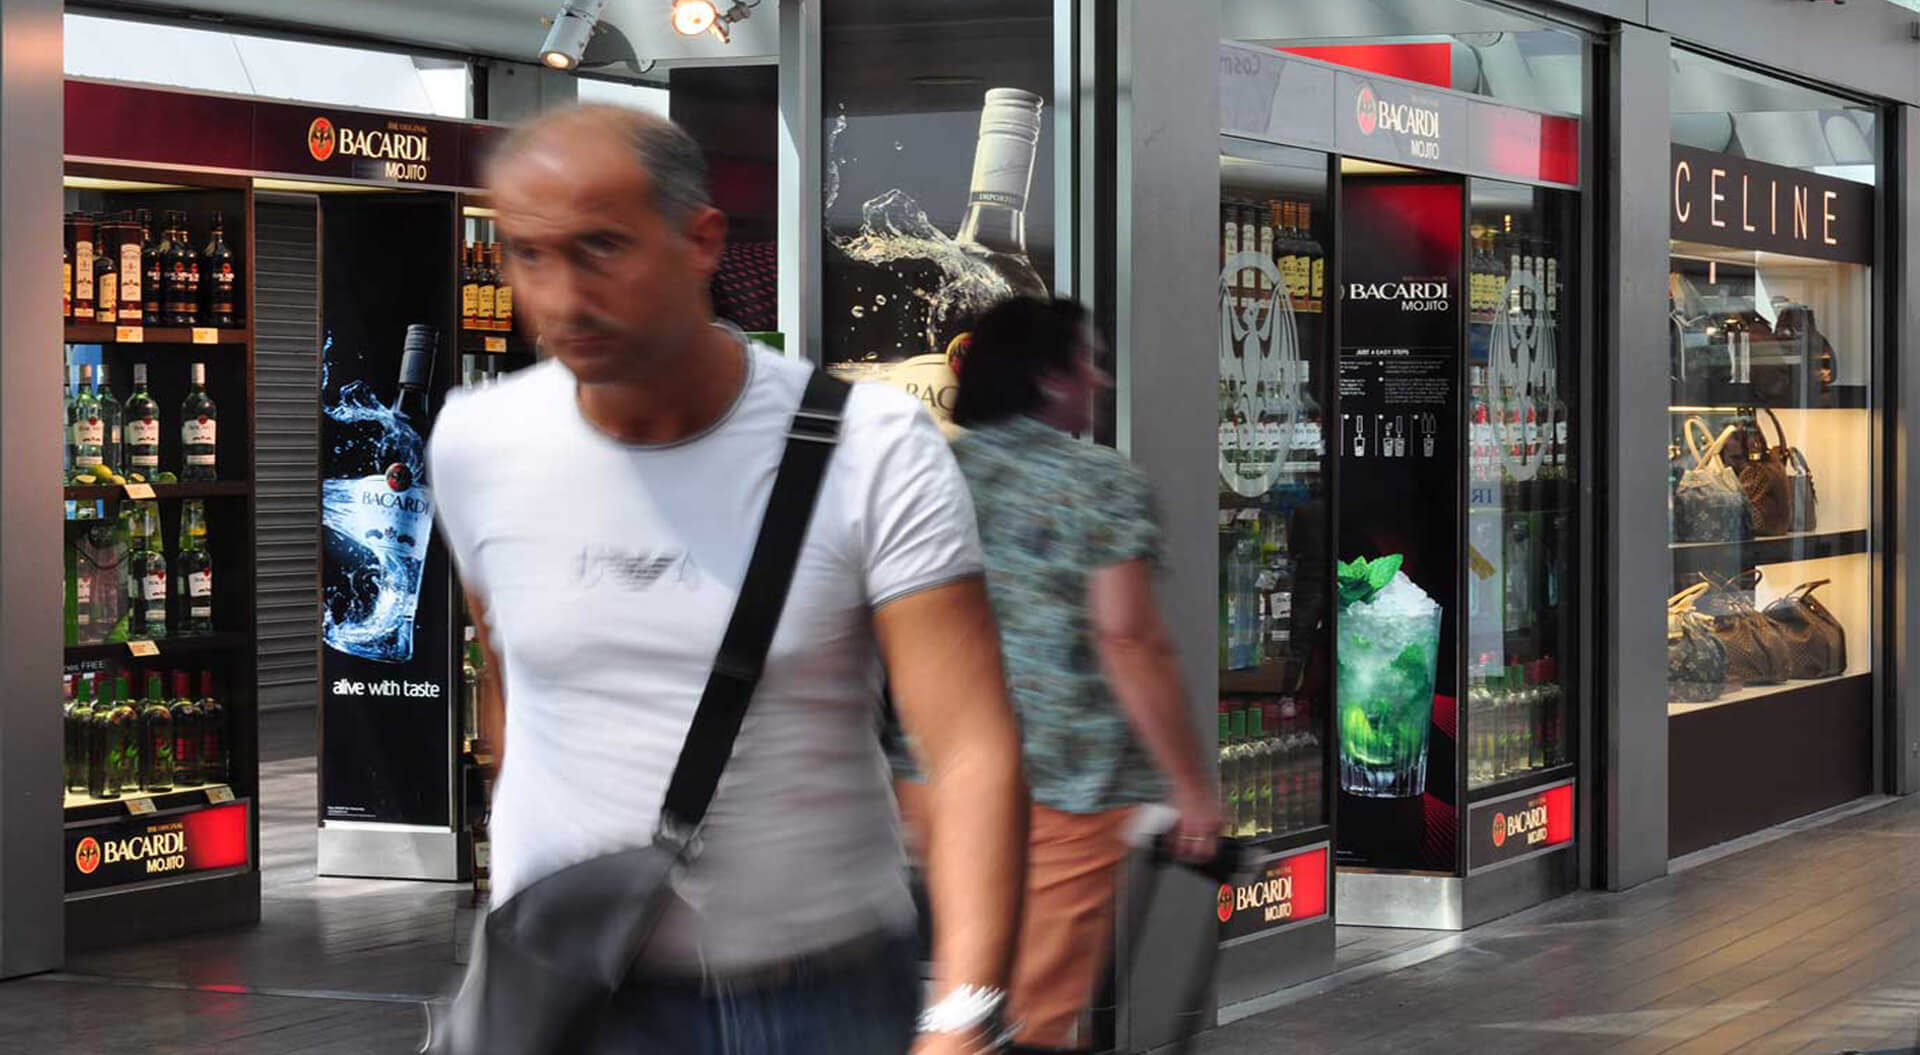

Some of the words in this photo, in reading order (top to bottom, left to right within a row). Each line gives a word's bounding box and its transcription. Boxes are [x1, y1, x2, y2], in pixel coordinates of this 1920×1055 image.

[1379, 100, 1439, 139] BACARDI
[339, 127, 430, 161] BACARDI
[1411, 139, 1439, 160] MOJITO
[385, 161, 427, 181] MOJITO
[1675, 160, 1837, 245] CELINE
[1350, 282, 1448, 301] BACARDI
[1401, 300, 1449, 312] MOJITO
[362, 491, 431, 515] BACARDI
[333, 679, 365, 696] alive
[368, 680, 401, 697] with
[403, 681, 440, 698] taste
[1507, 805, 1547, 837] BACARDI
[104, 831, 187, 864] BACARDI
[147, 855, 185, 873] MOJITO
[1236, 875, 1293, 912] BACARDI
